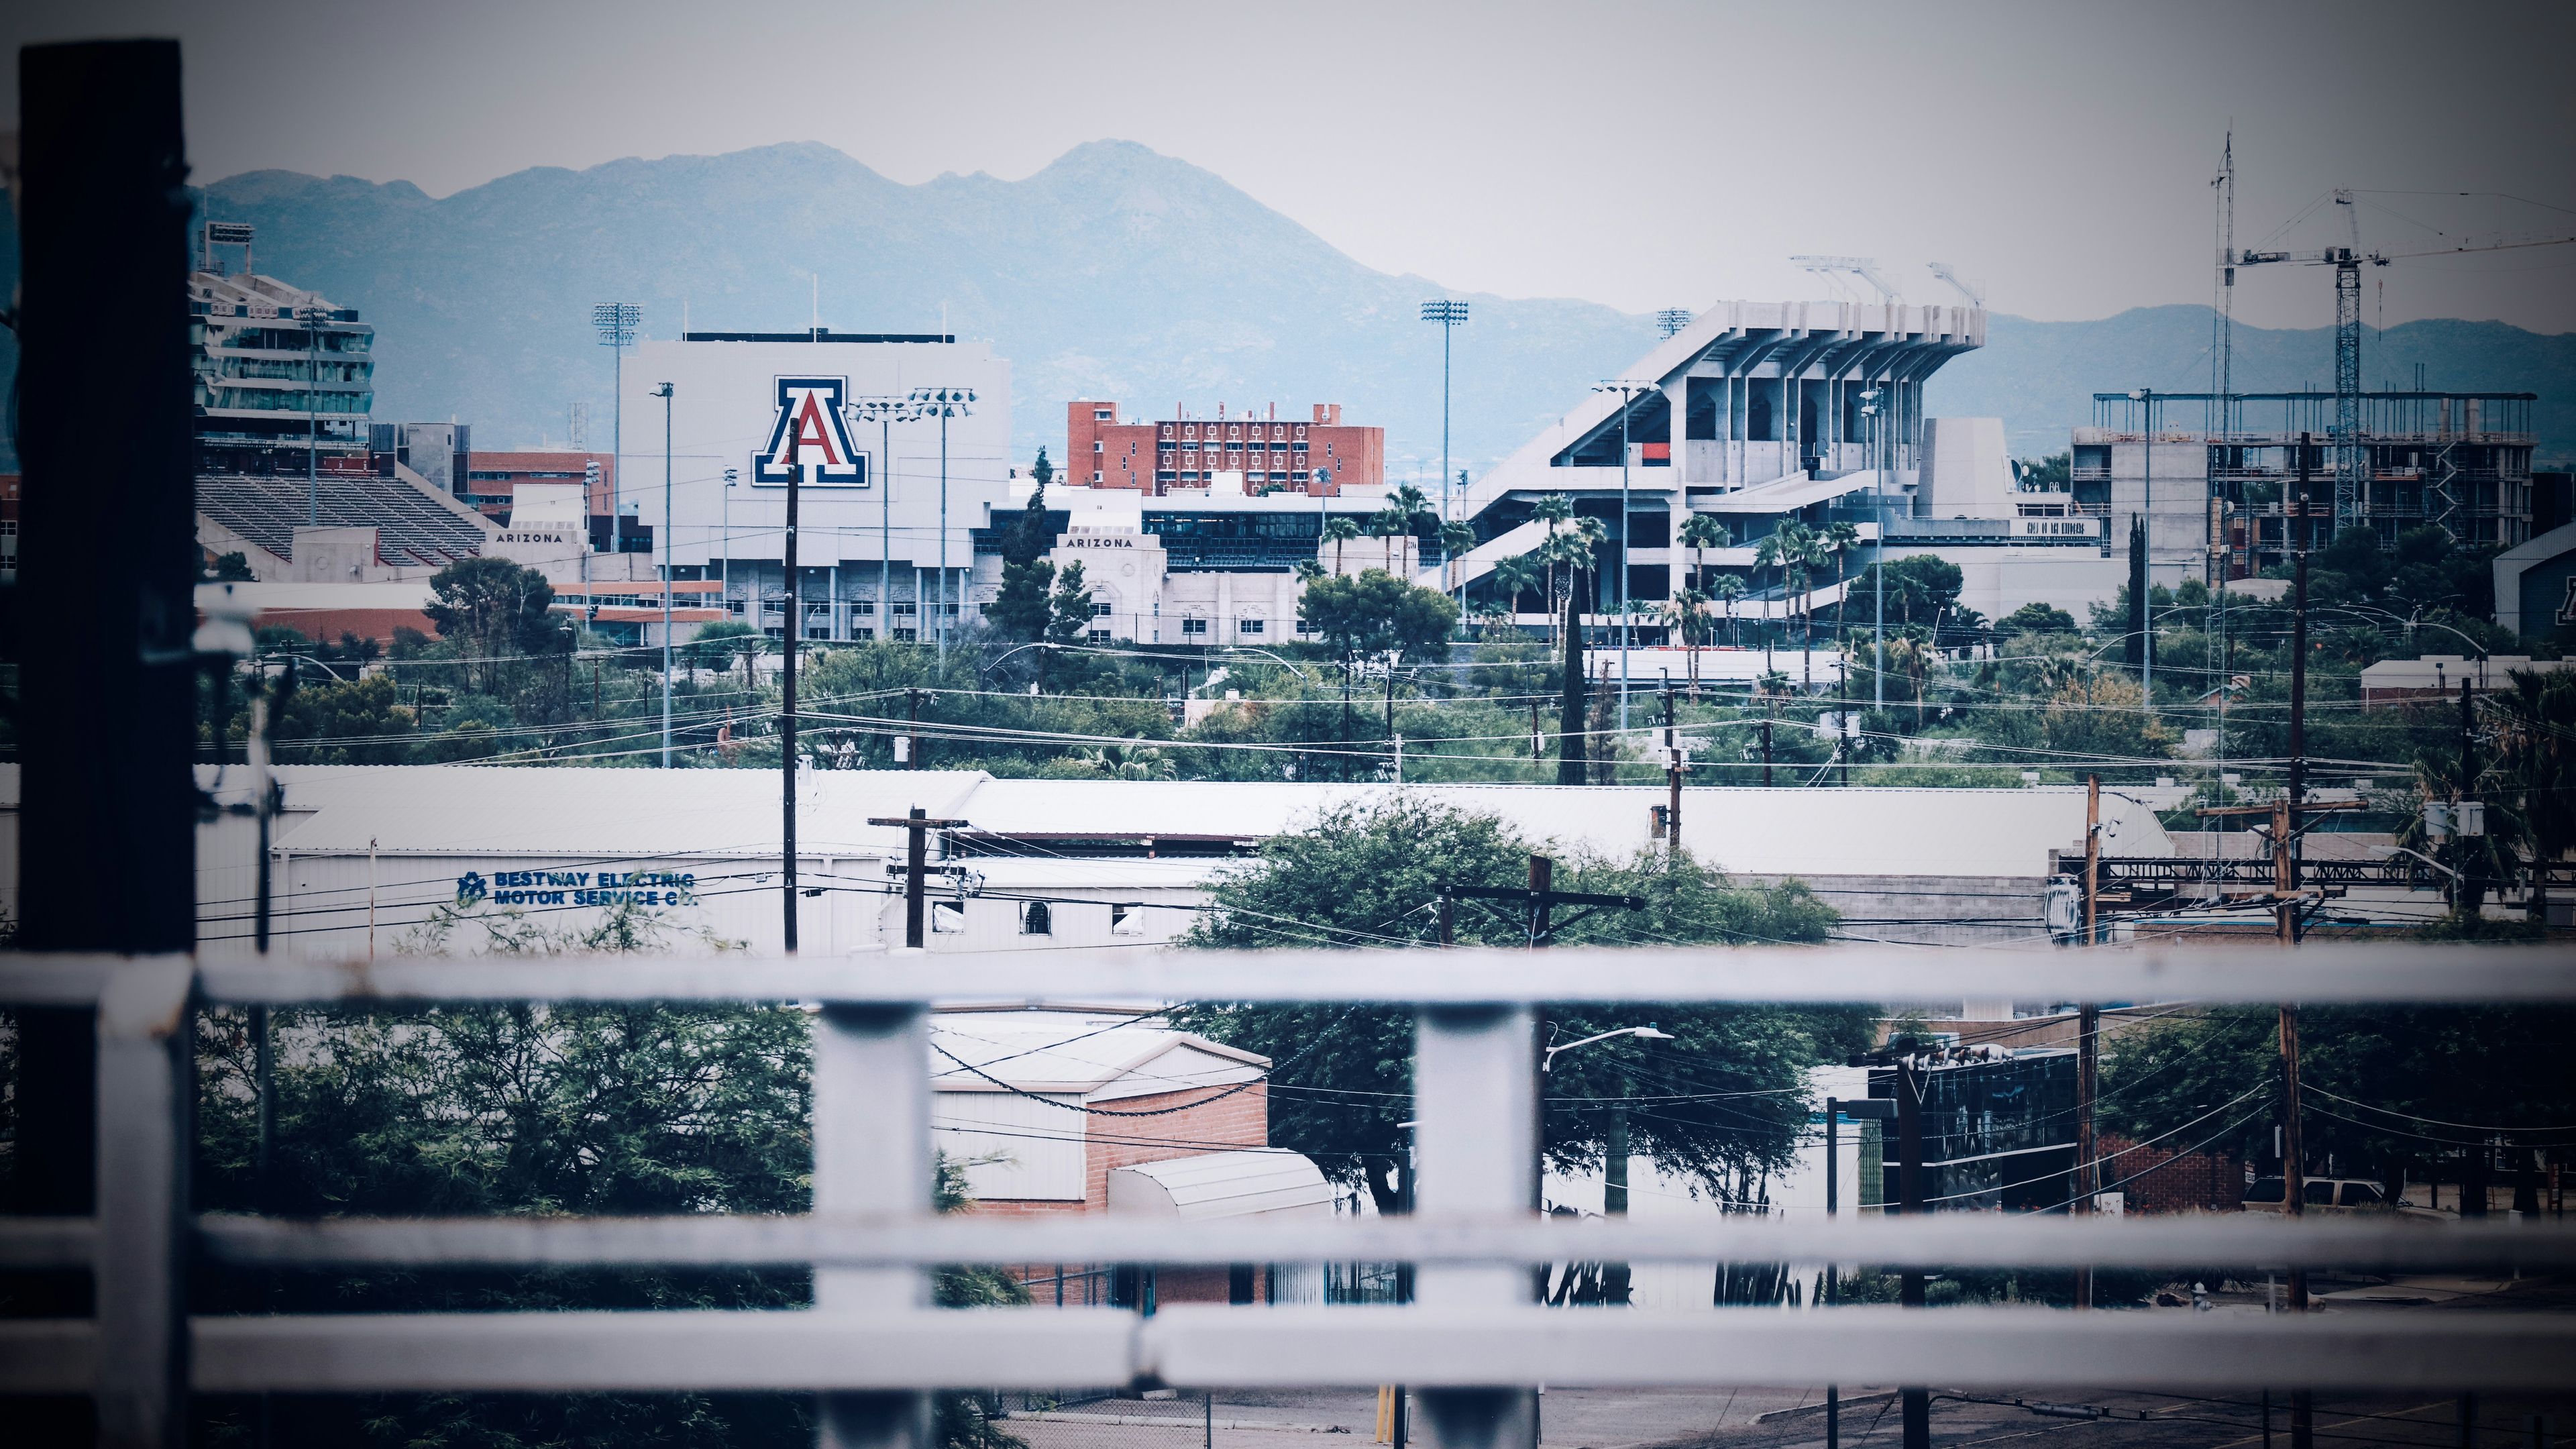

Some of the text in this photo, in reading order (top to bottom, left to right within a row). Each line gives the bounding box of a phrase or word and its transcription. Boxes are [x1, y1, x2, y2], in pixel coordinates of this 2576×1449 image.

[751, 375, 870, 488] A
[496, 534, 562, 543] ARIZONA
[1067, 539, 1132, 548] ARIZONA
[495, 872, 694, 888] BESTWAY ELECTRIC
[495, 890, 565, 904] MOTOR
[574, 891, 657, 905] SERVICE
